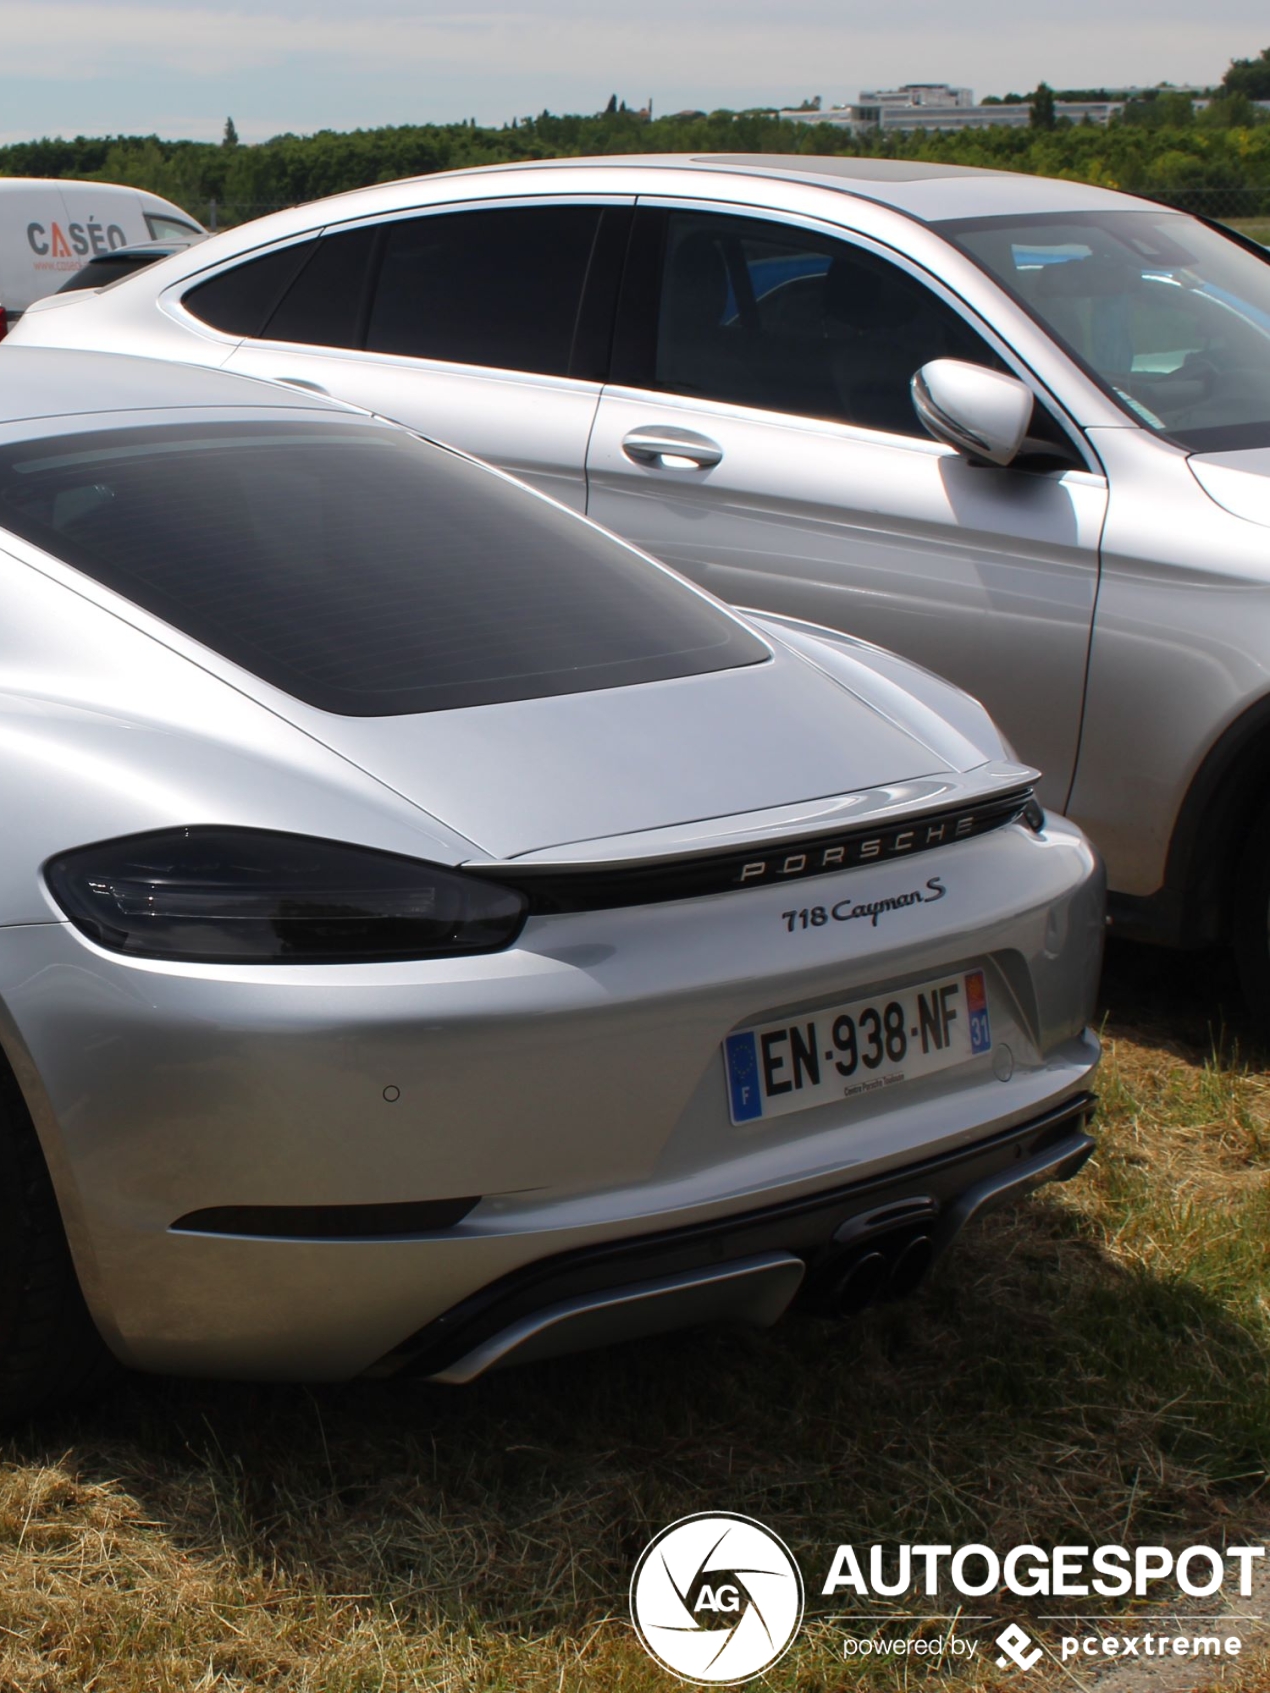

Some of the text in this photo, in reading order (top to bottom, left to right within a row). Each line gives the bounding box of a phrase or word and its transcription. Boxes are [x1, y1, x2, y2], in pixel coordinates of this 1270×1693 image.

[27, 215, 127, 257] CASÉO
[740, 817, 974, 882] PORSCHE
[782, 876, 946, 932] 718 Cayman S
[741, 1086, 750, 1105] F
[971, 1013, 990, 1045] 31
